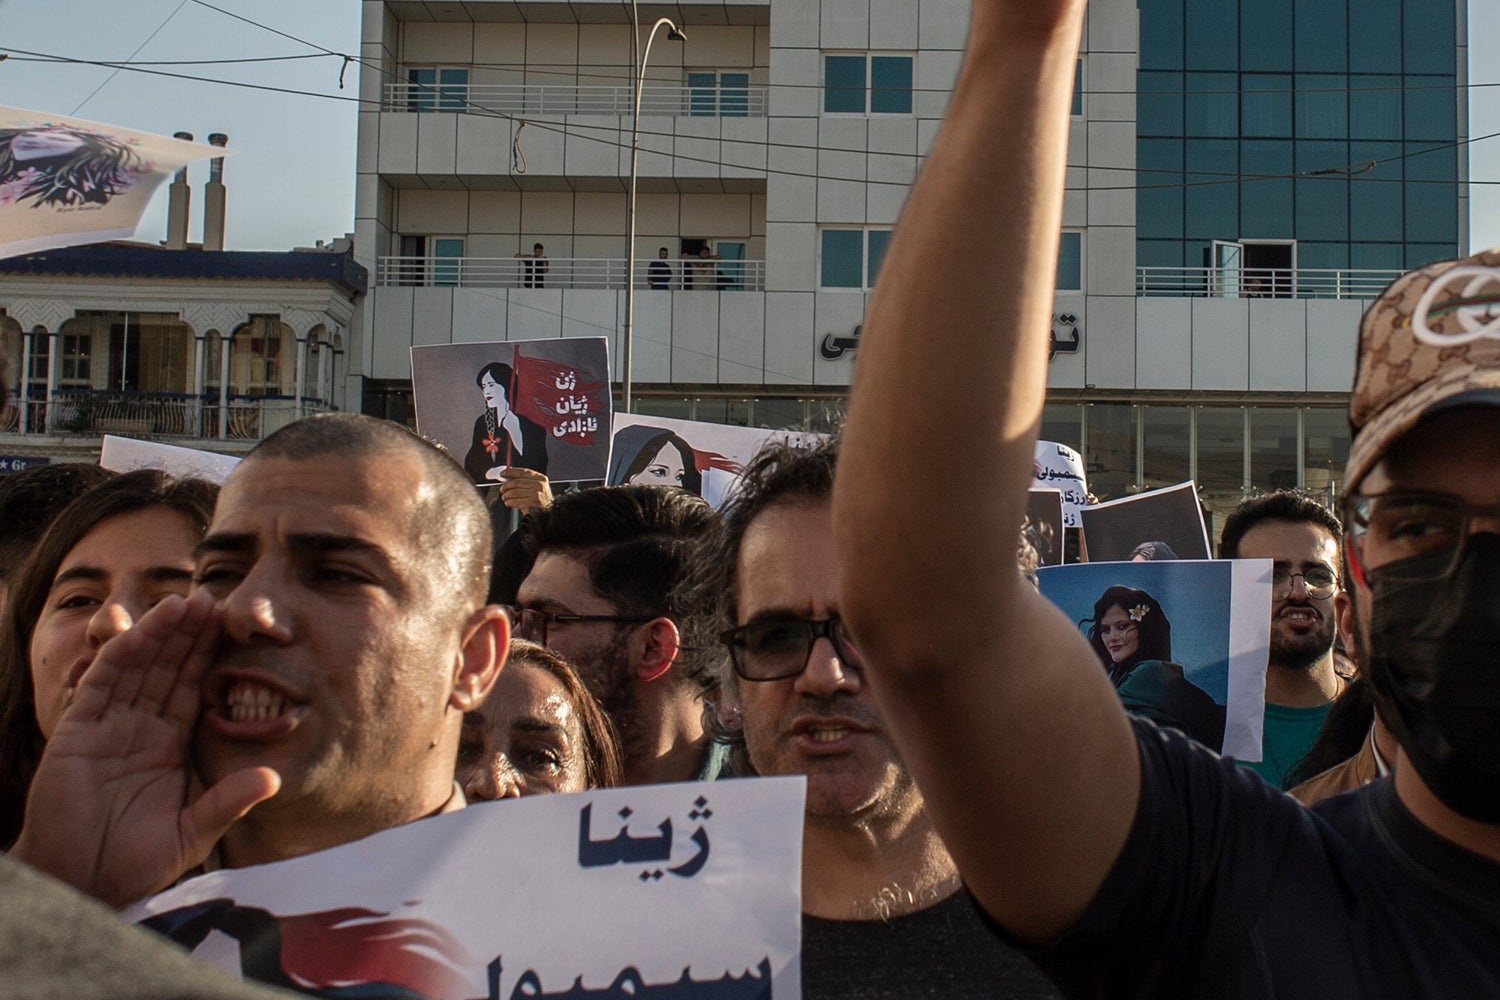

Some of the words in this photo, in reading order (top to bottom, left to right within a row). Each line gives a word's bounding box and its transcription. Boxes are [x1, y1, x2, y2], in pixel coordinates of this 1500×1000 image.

[555, 371, 577, 391] ژن
[556, 395, 588, 415] ژیان
[578, 795, 713, 883] ژینا
